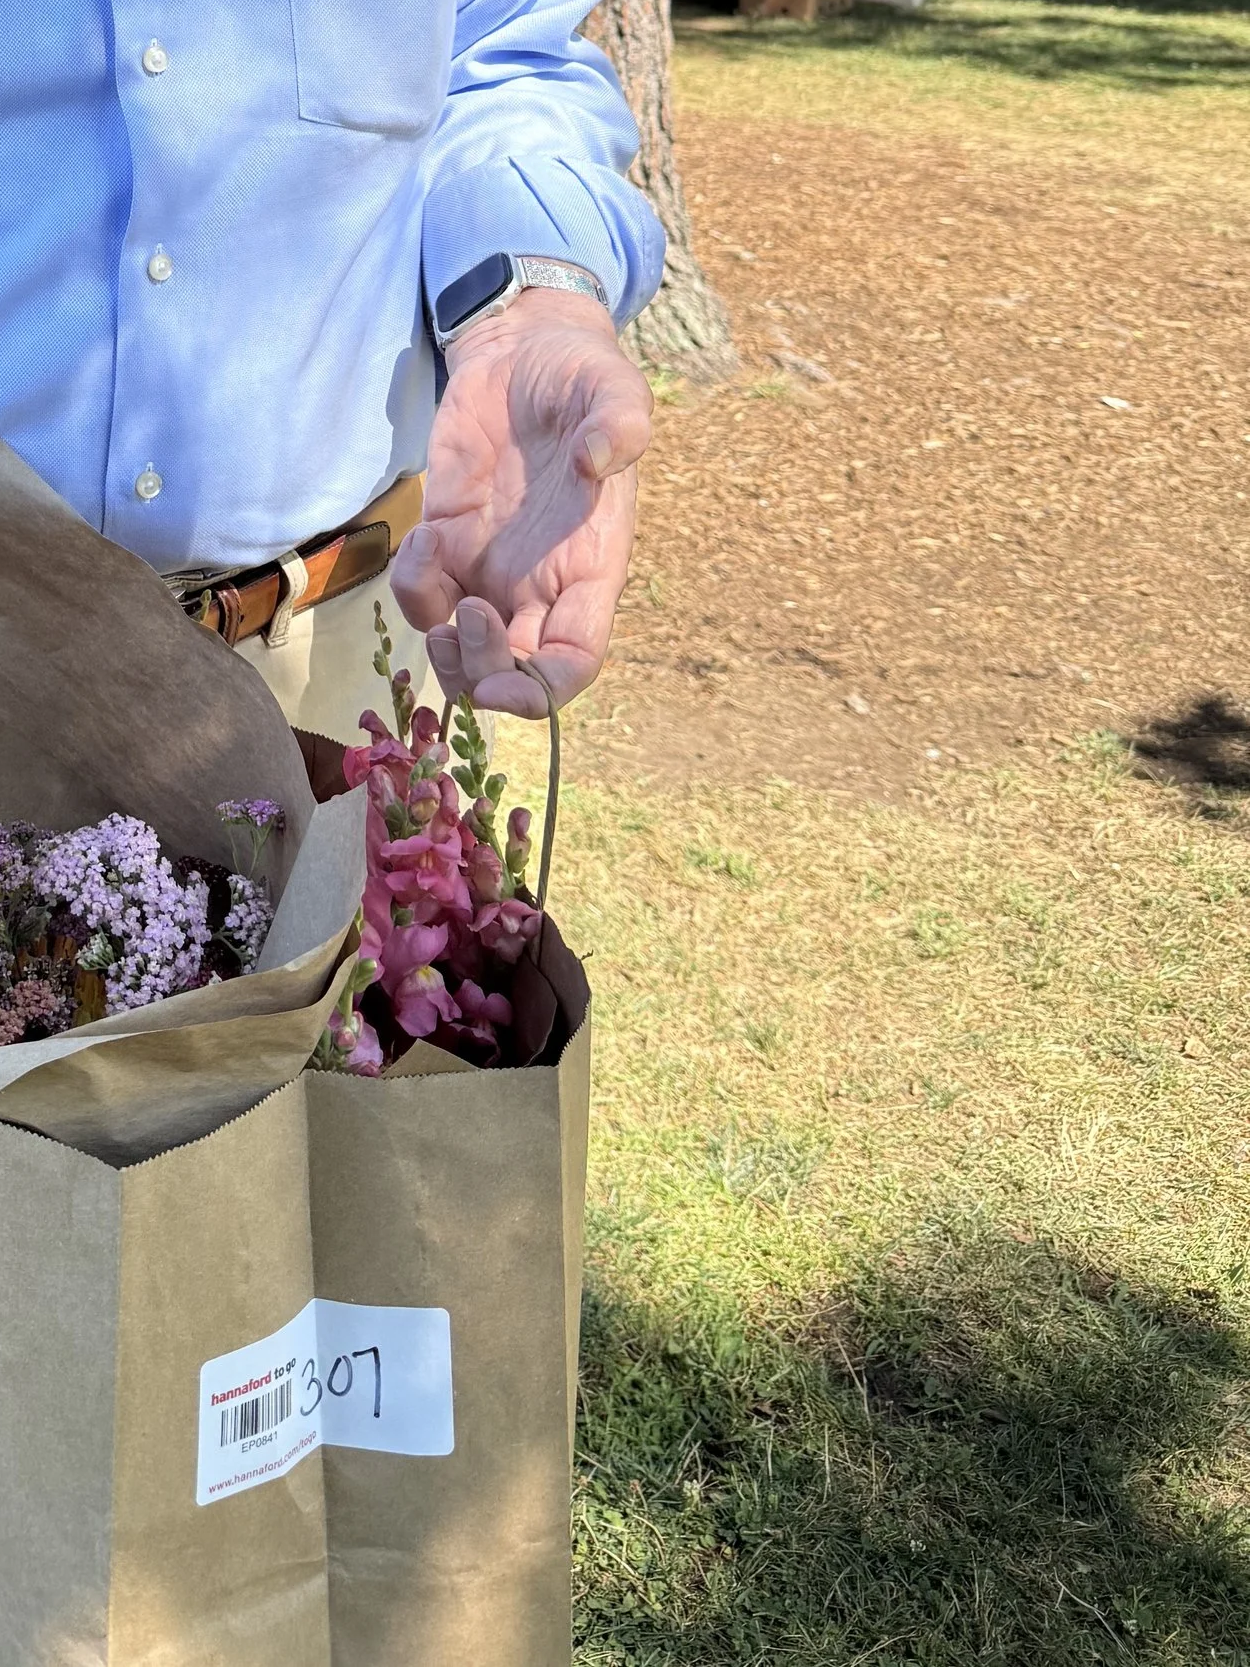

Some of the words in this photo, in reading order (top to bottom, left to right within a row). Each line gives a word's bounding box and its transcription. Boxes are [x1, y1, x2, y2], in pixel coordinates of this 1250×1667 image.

[211, 1370, 271, 1406] hannaford
[273, 1366, 285, 1380] to
[286, 1357, 297, 1375] go
[300, 1346, 381, 1418] 307
[208, 1430, 317, 1494] www.hannaford.com/togo
[241, 1431, 278, 1453] EP0841
